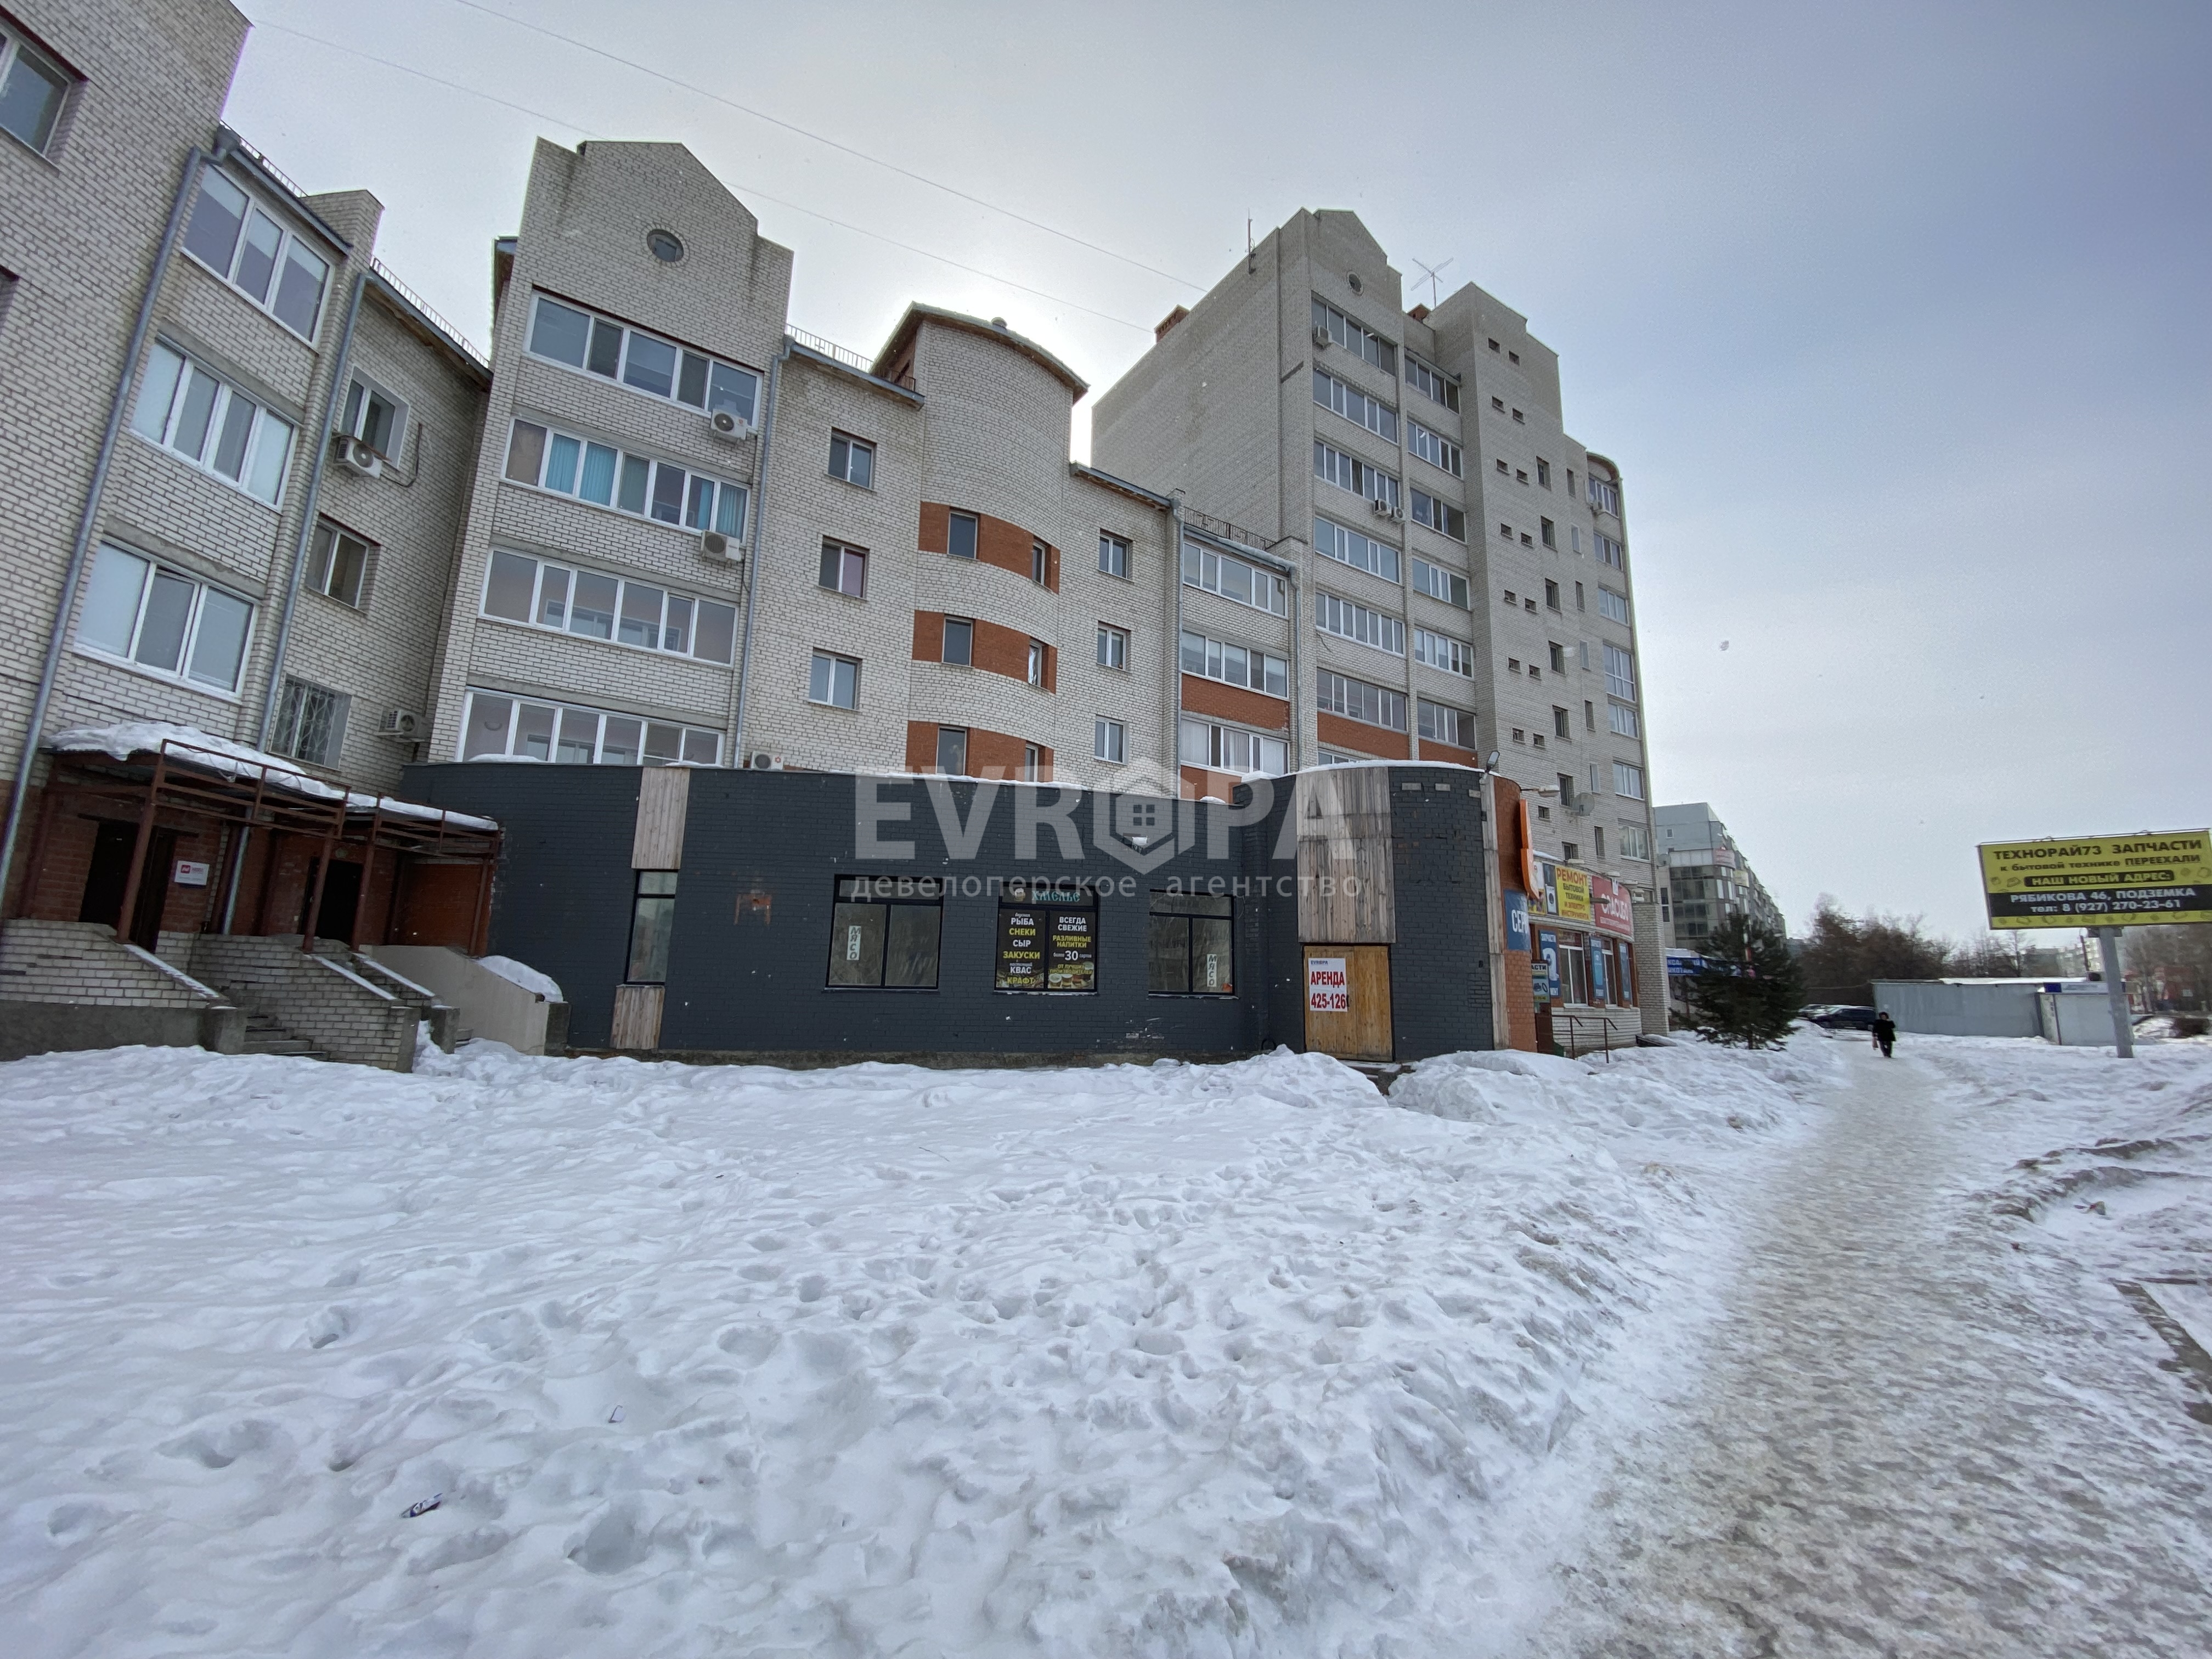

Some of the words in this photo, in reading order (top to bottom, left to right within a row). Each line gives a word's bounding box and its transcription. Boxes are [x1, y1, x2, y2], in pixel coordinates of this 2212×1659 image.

[1993, 844, 2102, 860] ТЕХНОРАЙ73
[2112, 839, 2202, 854] ЗАПЧАСТИ
[2012, 862, 2065, 871] бытовой
[2125, 854, 2200, 866] ПЕРЕЕХАЛИ
[1556, 867, 1587, 887] РЕМОНТ
[2032, 877, 2064, 885] НАШ
[2068, 873, 2119, 884] НОВЫЙ
[2124, 872, 2171, 882] АДРЕС:
[2010, 891, 2086, 903] РЯБИКОВА
[2090, 891, 2111, 901] 46,
[2115, 888, 2196, 899] ПОДЗЕМКА
[2062, 903, 2070, 912] 8
[2075, 902, 2108, 913] (927)
[2112, 899, 2181, 910] 270-23-61
[1011, 917, 1034, 926] РЫБА
[1059, 916, 1086, 924] ВСЕГДА
[1511, 909, 1529, 934] СЕР
[1009, 928, 1036, 936] СНЕКИ
[1013, 939, 1031, 947] СЫР
[1003, 951, 1040, 960] ЗАКУСКИ
[1064, 950, 1079, 961] 30
[1007, 977, 1034, 985] КРАФТ
[1311, 971, 1345, 988] АРЕНДА
[1311, 993, 1346, 1009] 425-126
